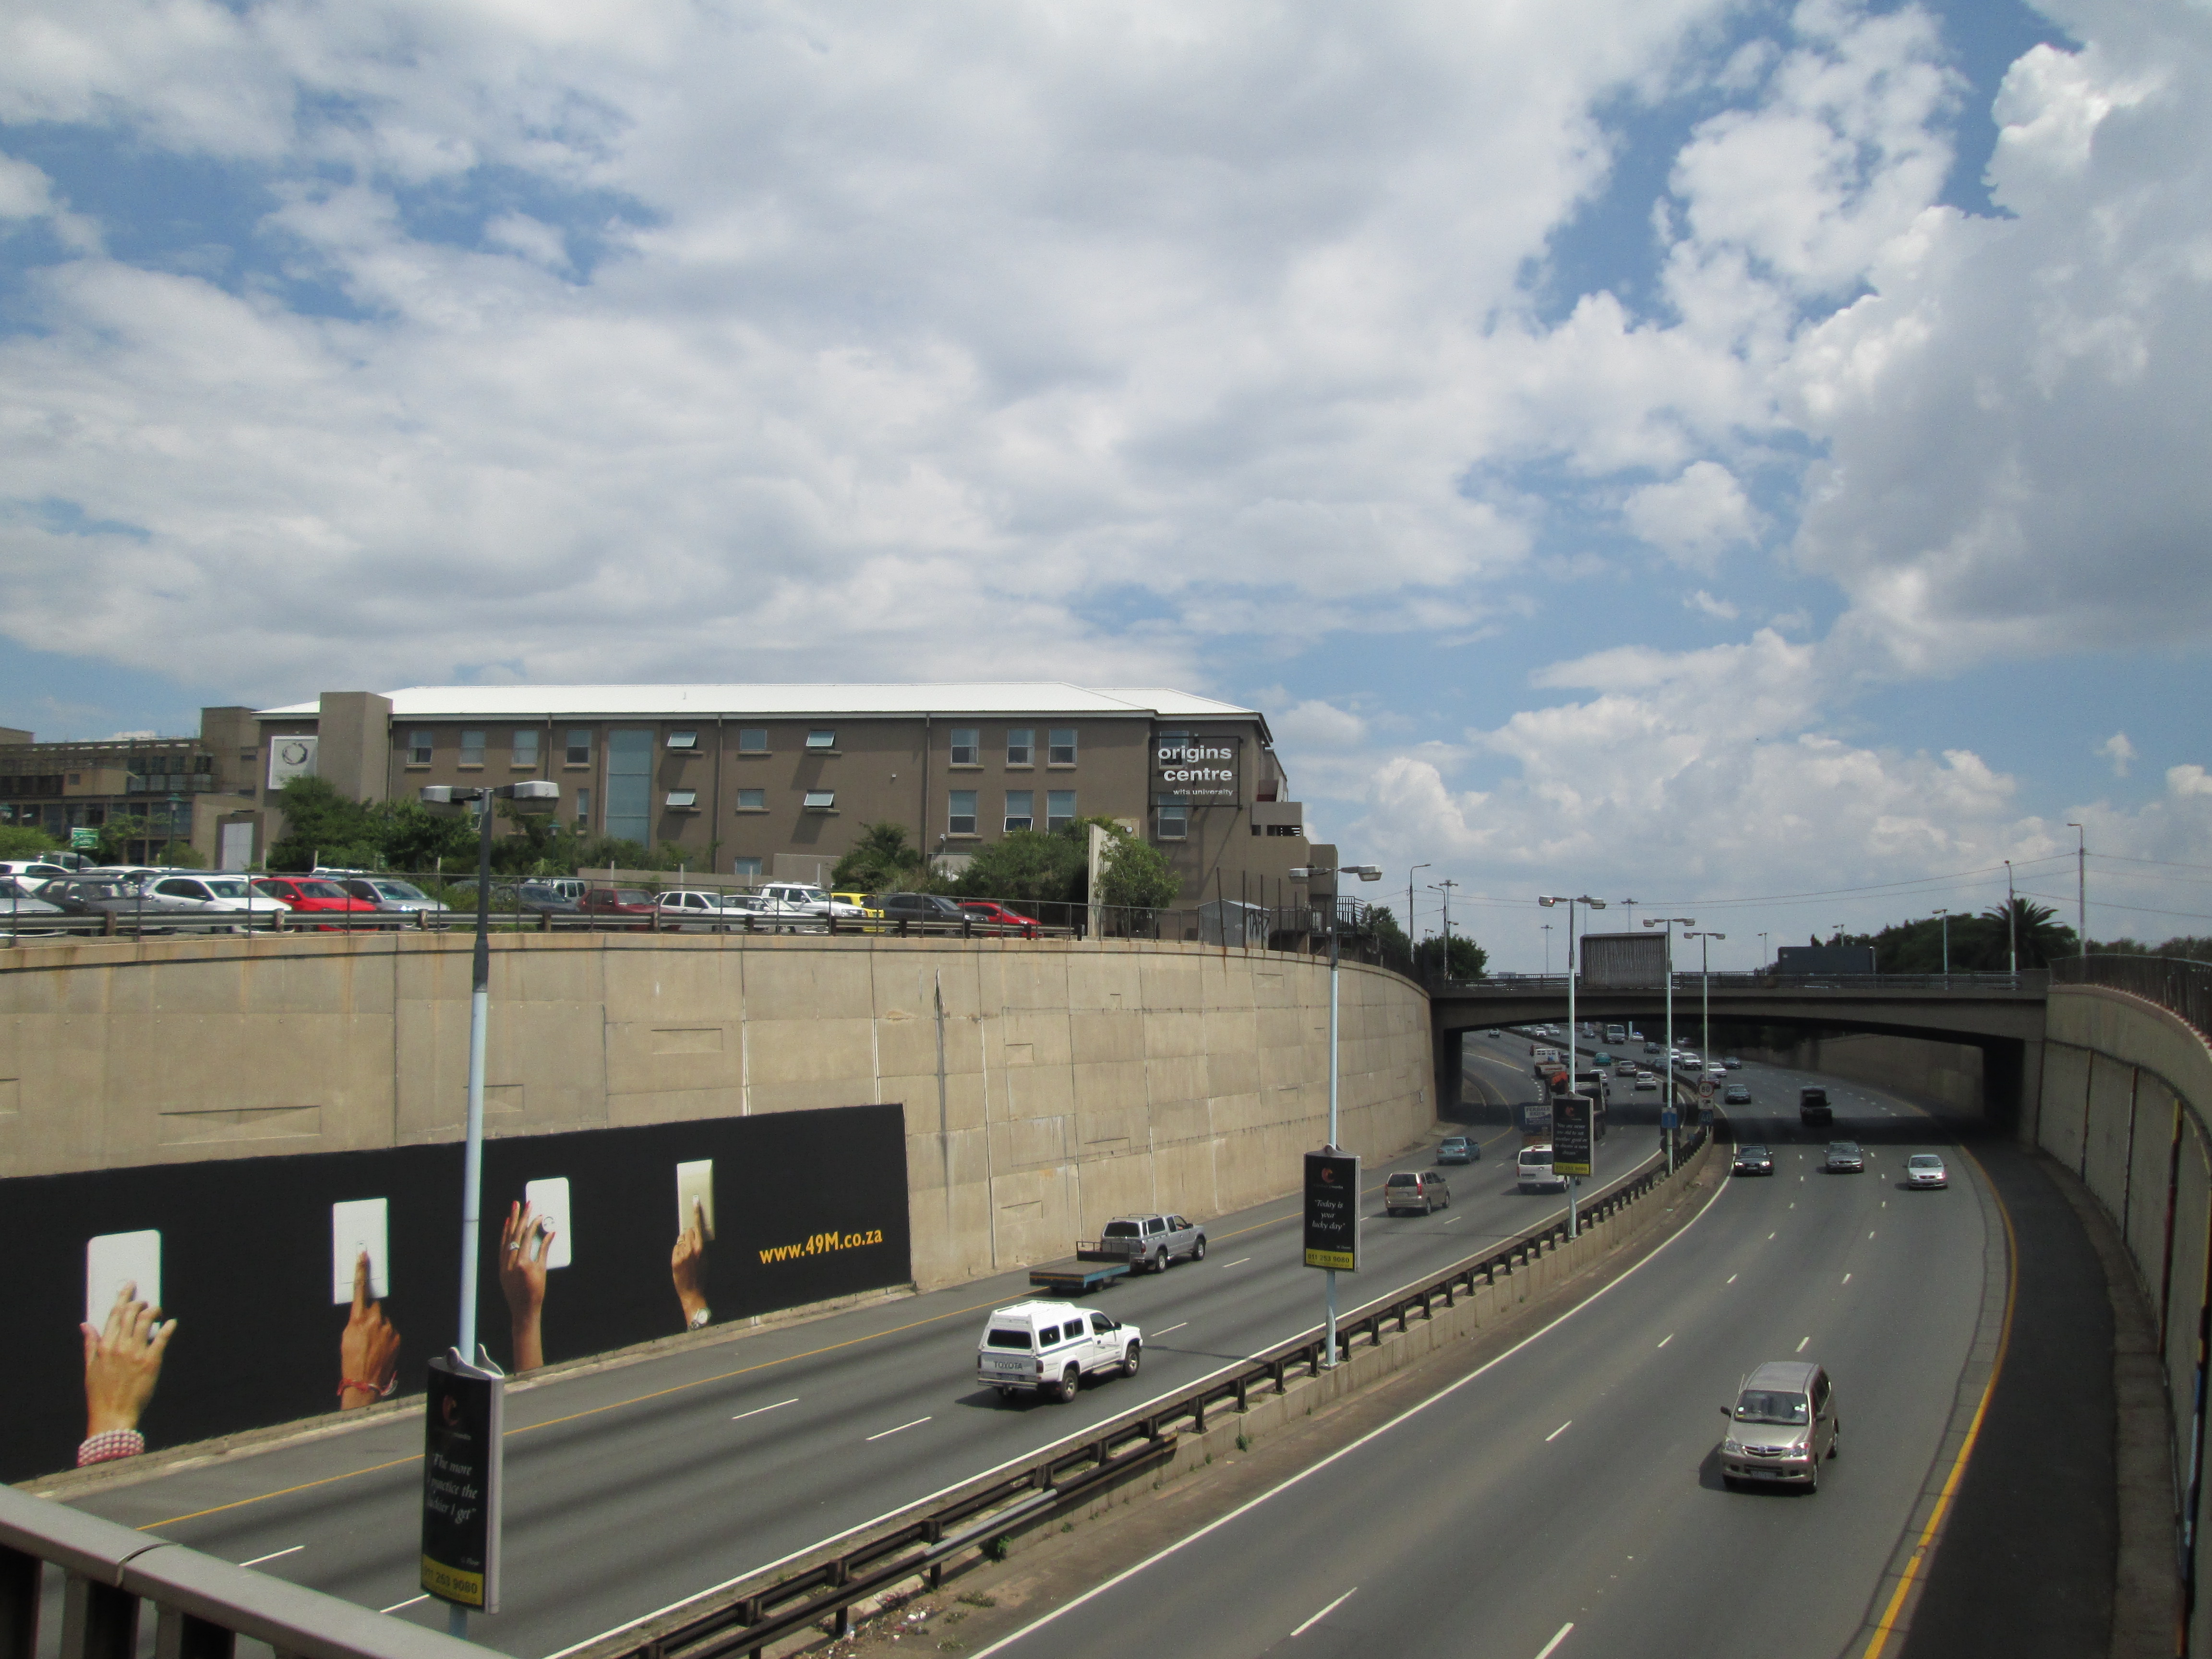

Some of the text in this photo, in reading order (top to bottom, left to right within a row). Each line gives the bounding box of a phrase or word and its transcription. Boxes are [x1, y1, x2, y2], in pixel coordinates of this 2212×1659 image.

[1158, 745, 1232, 763] origins
[1164, 768, 1233, 781] centre
[1312, 1220, 1328, 1231] lucky
[759, 1229, 883, 1264] www.49M.co.za
[994, 1361, 1023, 1370] TOYOTA
[461, 1484, 479, 1499] the
